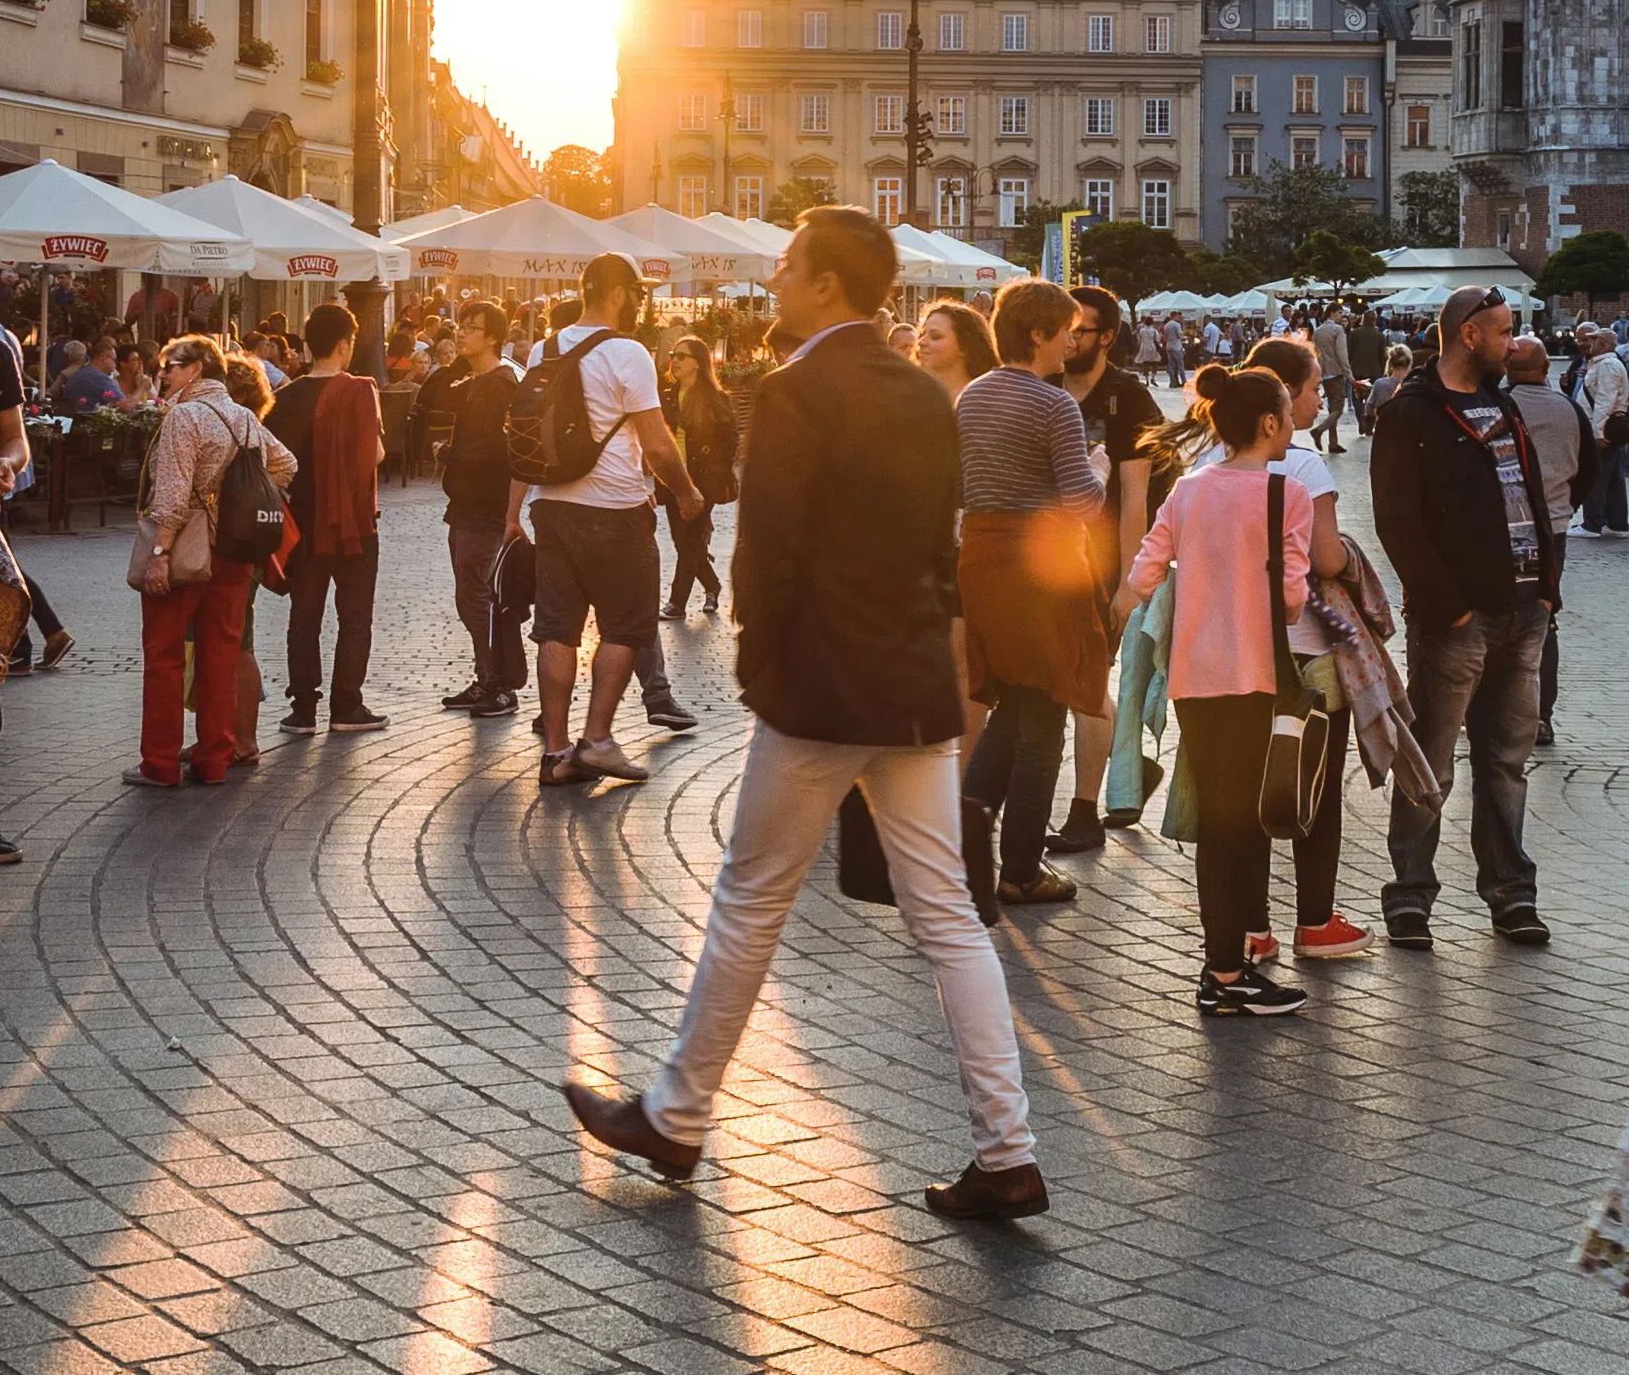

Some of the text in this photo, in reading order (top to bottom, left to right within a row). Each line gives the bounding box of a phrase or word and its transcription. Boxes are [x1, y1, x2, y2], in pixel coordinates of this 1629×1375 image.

[50, 237, 102, 255] ŻYWIEC
[292, 257, 333, 272] ŻYWIEC
[522, 258, 567, 274] MAX
